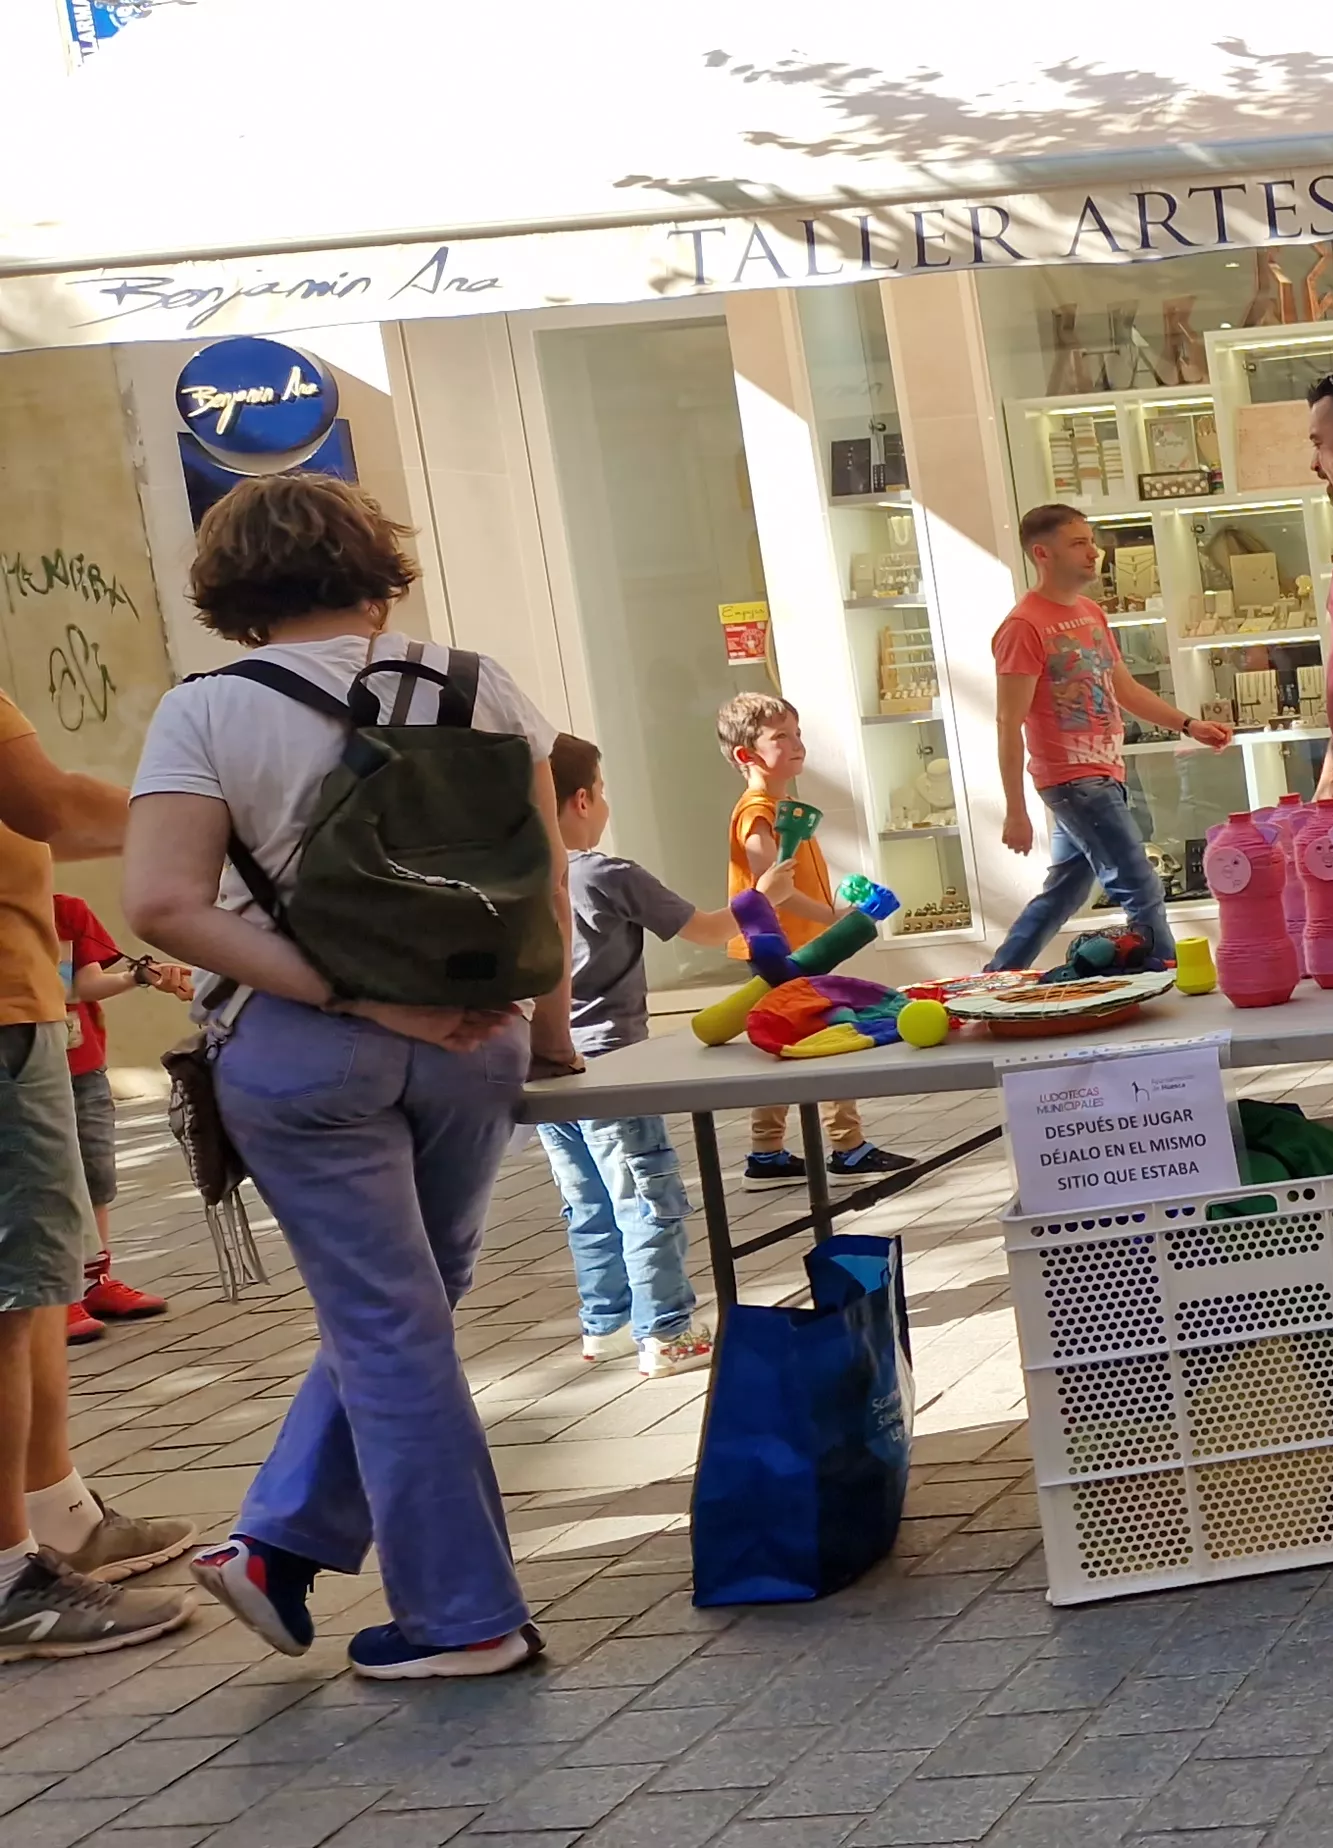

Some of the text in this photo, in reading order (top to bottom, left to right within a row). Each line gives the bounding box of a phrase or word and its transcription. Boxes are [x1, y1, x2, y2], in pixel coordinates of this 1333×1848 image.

[668, 204, 1033, 287] TALLER
[67, 269, 372, 330] Benjamin
[181, 383, 274, 436] Benjamin
[1036, 1098, 1104, 1115] MUNICIPALES
[1039, 1087, 1100, 1103] LUDOTECAS
[1045, 1108, 1194, 1140] DESPUÉS DE JUGAR
[1040, 1133, 1207, 1167] DÉJALO EN EL MISMO
[1057, 1160, 1200, 1191] SITIO QUE ESTABA
